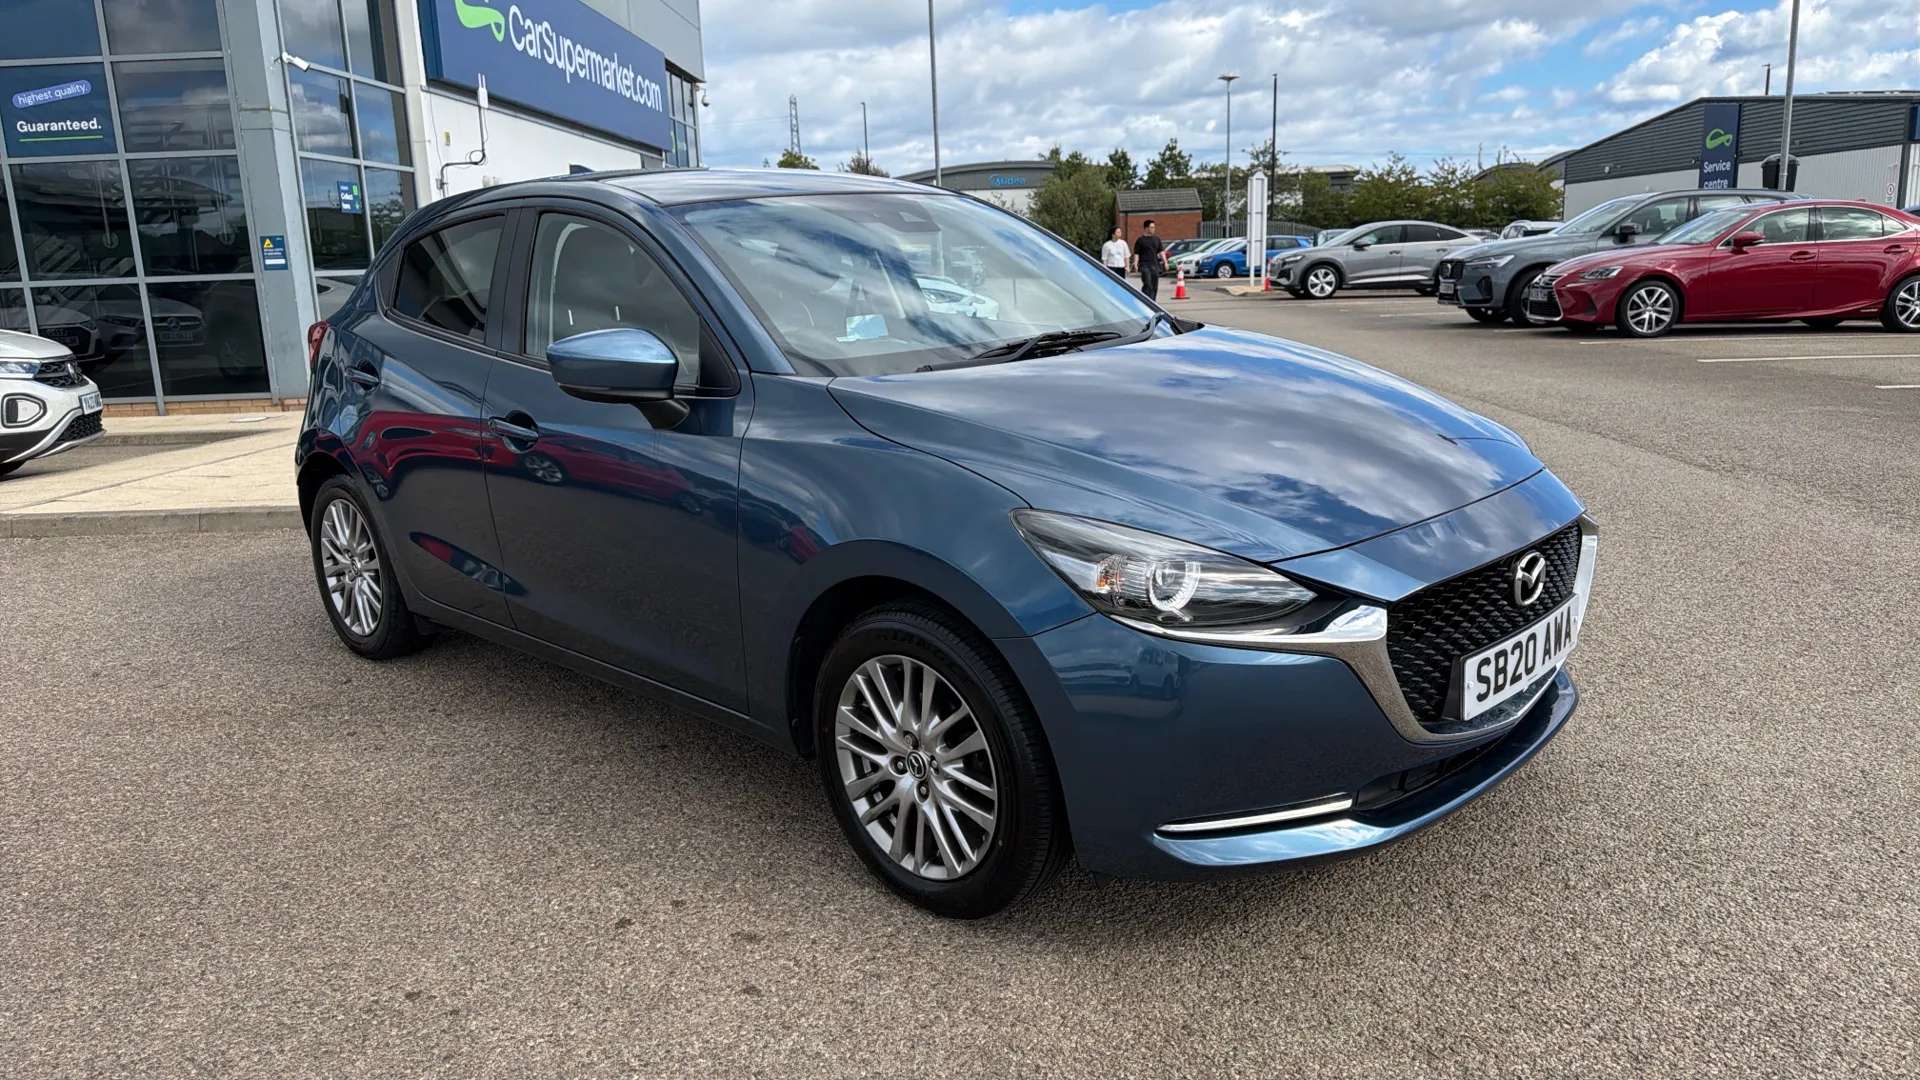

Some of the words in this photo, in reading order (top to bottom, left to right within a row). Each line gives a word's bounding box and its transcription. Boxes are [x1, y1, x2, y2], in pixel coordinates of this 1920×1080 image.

[508, 4, 663, 113] CarSupermarket.com
[17, 89, 53, 105] highest
[54, 83, 89, 99] quality.
[16, 116, 102, 133] Guaranteed.
[1703, 159, 1731, 173] Service
[1703, 178, 1728, 189] centre
[1476, 632, 1536, 702] SB20
[1542, 606, 1571, 665] AWA
